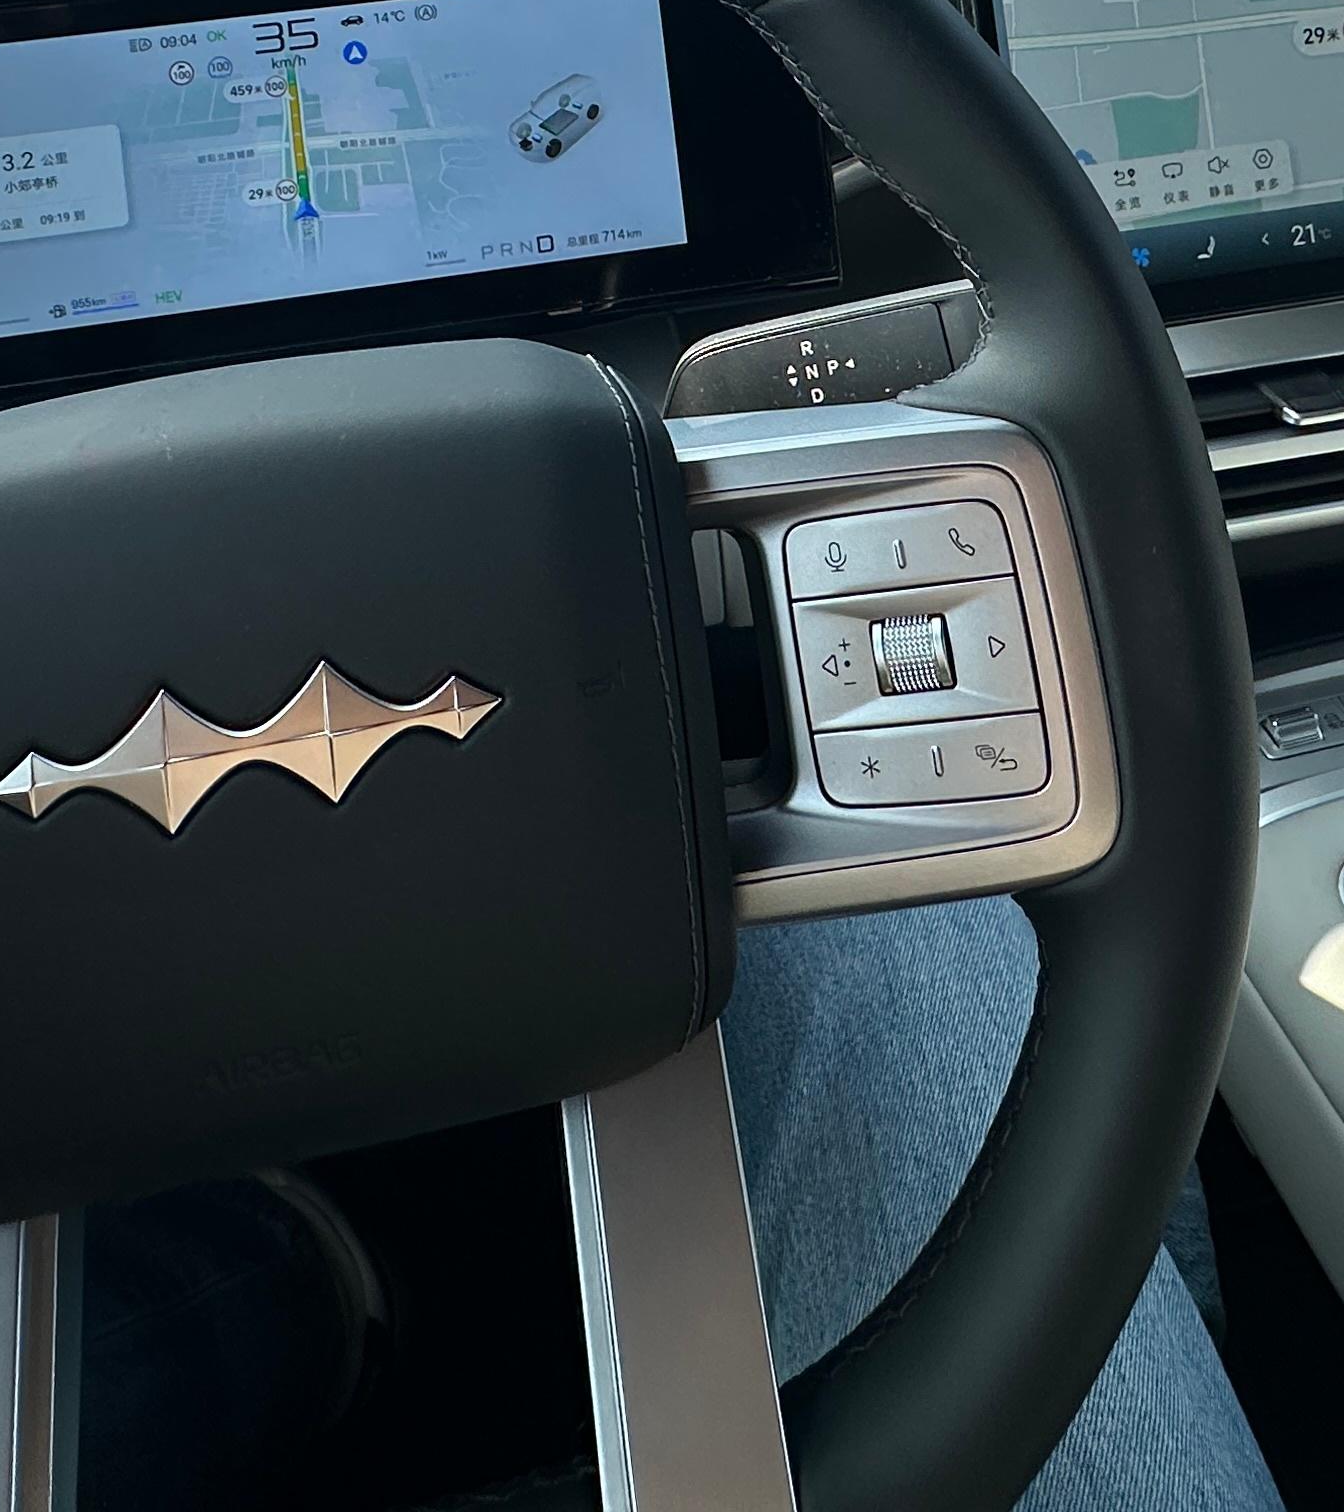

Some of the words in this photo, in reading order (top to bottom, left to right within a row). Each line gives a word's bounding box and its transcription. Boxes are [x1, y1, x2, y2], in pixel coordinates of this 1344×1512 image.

[159, 33, 197, 49] 09:04
[206, 29, 227, 43] OK
[252, 17, 319, 55] 35
[210, 61, 230, 74] 100
[271, 55, 307, 70] km/h
[172, 69, 192, 81] 100
[266, 80, 286, 92] 100
[4, 176, 59, 194] 小郊亭桥
[276, 184, 296, 196] 100
[1209, 183, 1235, 198] 静音
[1254, 177, 1280, 192] 更多
[1114, 196, 1143, 213] 全览
[1163, 190, 1190, 205] 仪表
[155, 289, 184, 305] HEV
[800, 340, 814, 357] R
[804, 363, 820, 380] N
[827, 359, 839, 376] P
[810, 387, 825, 404] D
